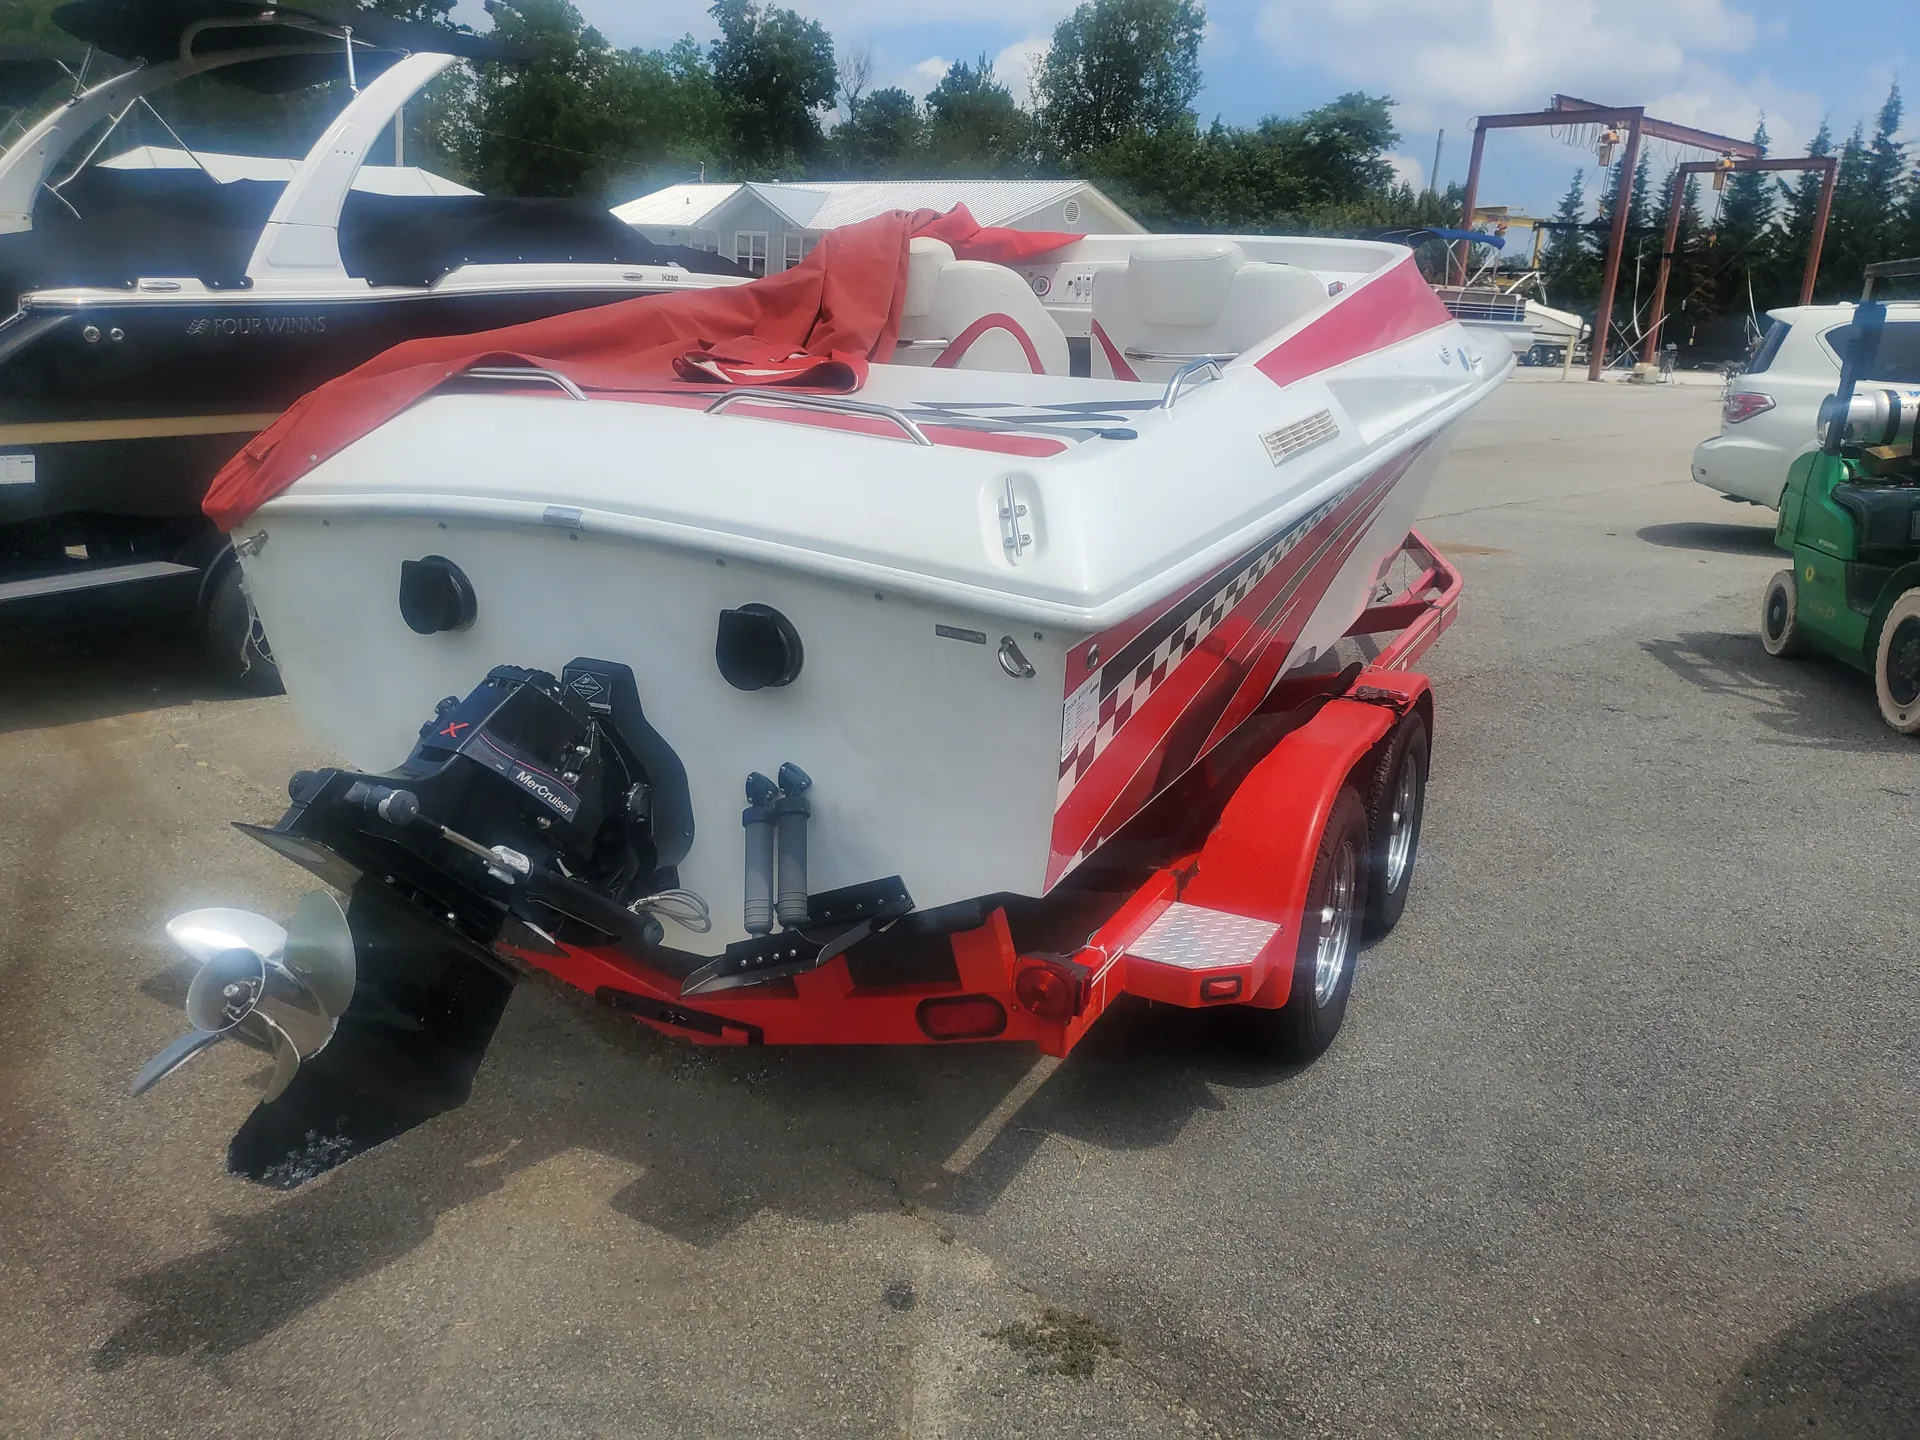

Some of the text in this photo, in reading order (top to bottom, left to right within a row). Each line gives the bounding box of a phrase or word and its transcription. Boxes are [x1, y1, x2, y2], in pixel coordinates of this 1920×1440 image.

[214, 316, 327, 335] FOUR WINNS
[515, 770, 573, 815] MerCruiser
